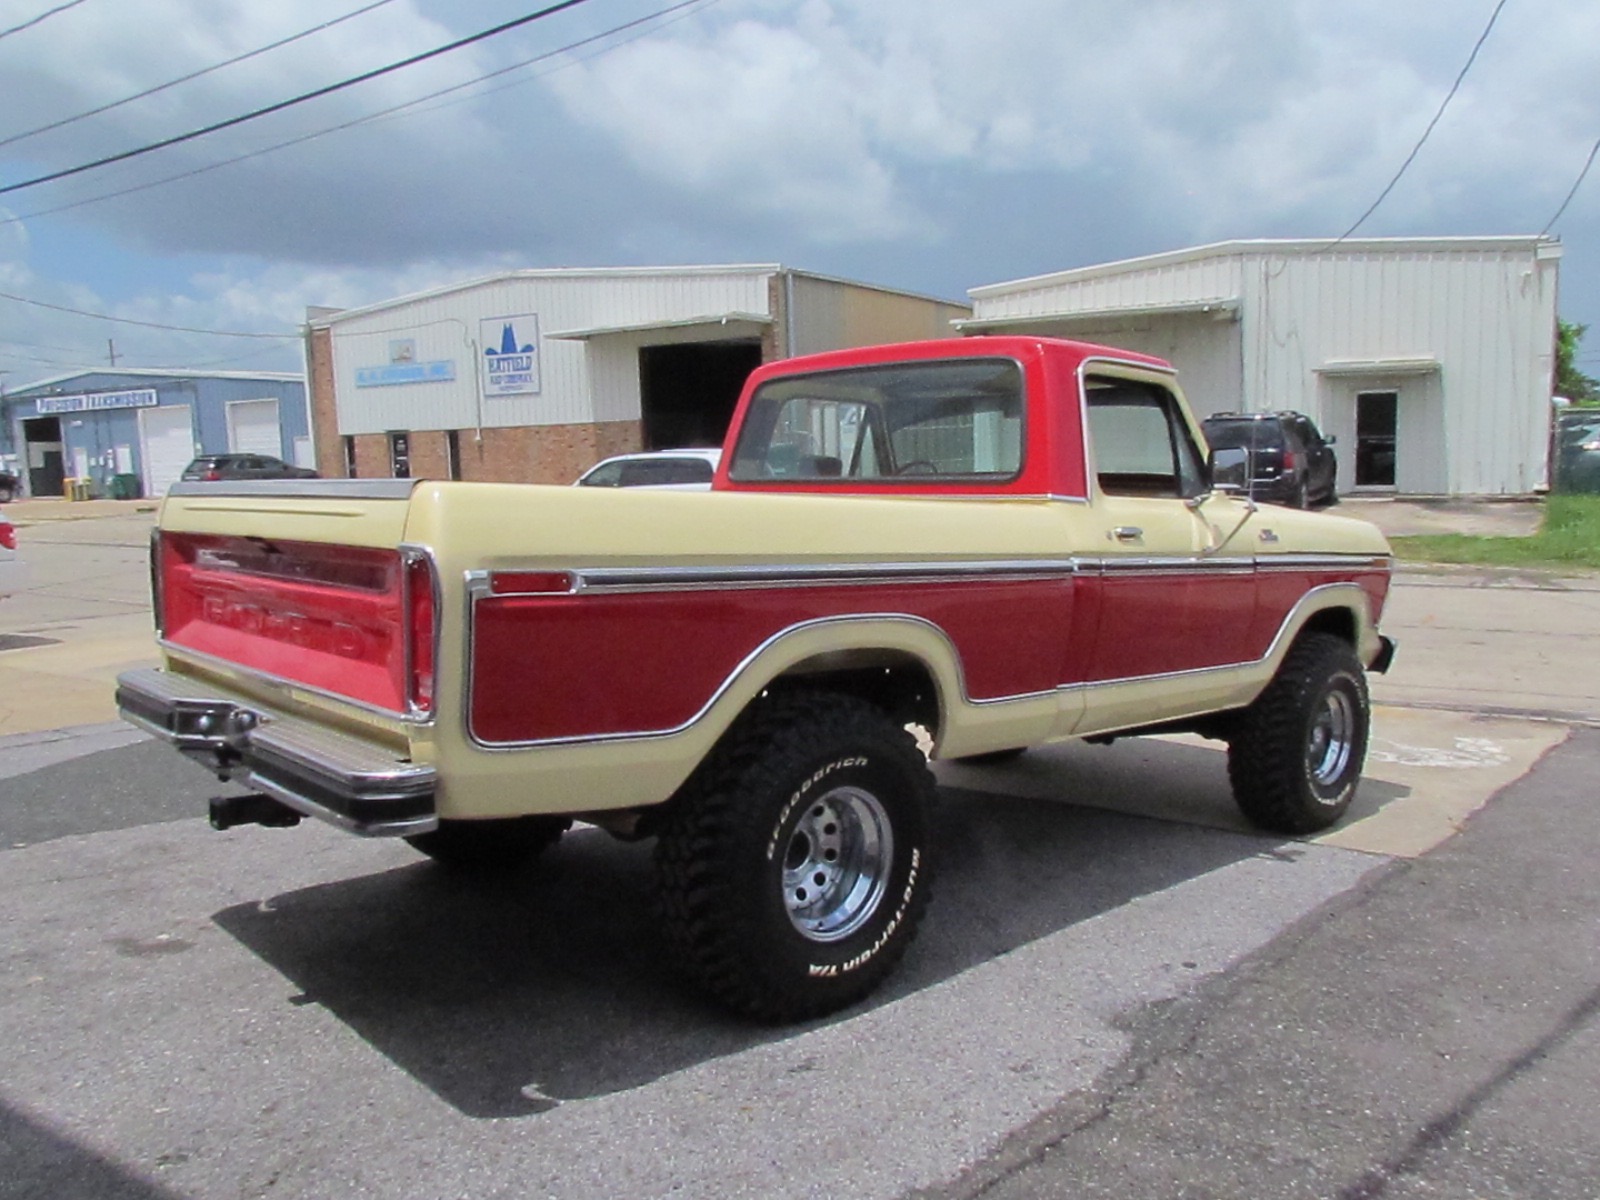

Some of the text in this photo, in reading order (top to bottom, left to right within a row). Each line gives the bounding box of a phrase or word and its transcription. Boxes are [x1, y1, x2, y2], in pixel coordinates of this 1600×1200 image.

[489, 355, 532, 374] HATFIELD
[203, 595, 366, 660] FORD
[808, 963, 838, 977] T/A
